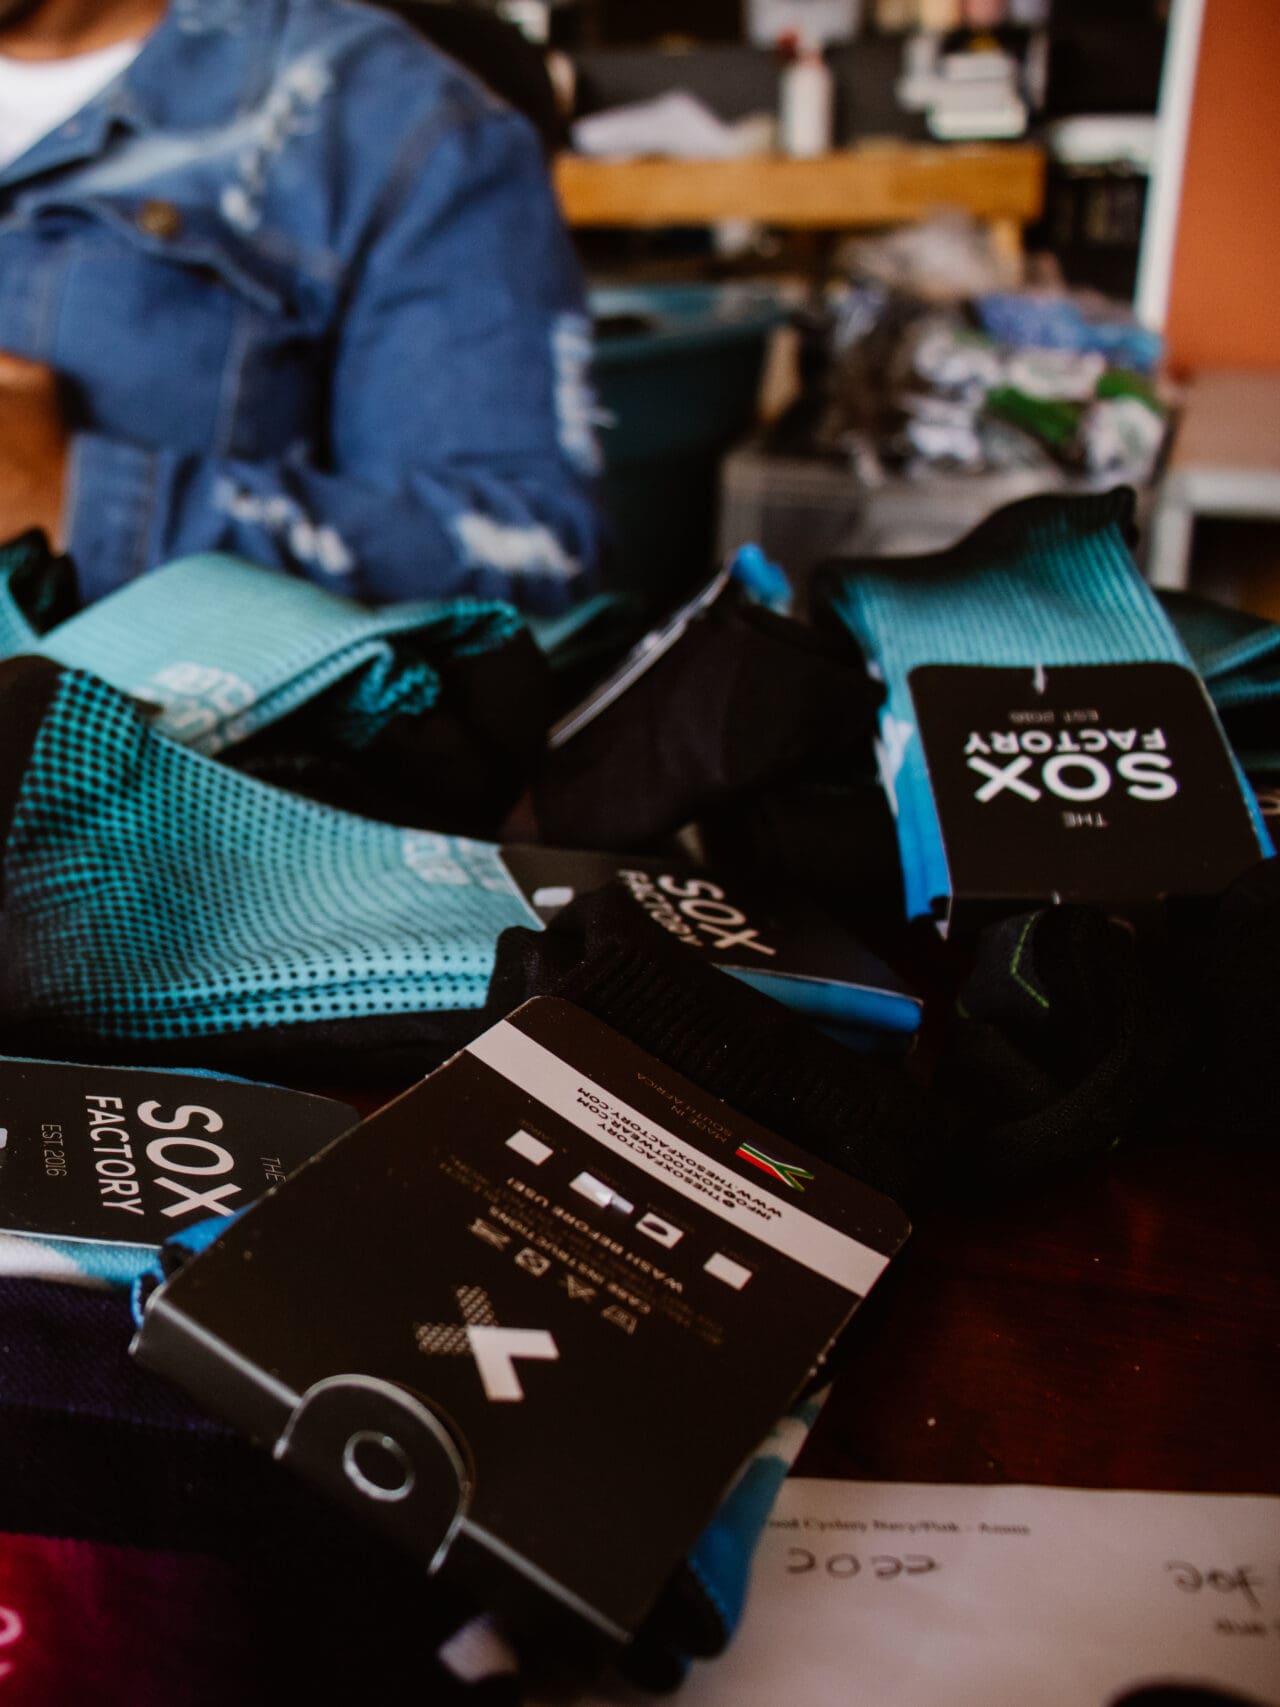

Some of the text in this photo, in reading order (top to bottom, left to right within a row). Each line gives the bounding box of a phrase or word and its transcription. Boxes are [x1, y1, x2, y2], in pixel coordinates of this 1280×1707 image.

[964, 728, 1167, 755] FACTORY
[966, 752, 1178, 803] SOX
[657, 874, 776, 956] SOX
[44, 1149, 67, 1176] 2016
[85, 1095, 145, 1216] FACTORY
[137, 1100, 242, 1218] SOX
[260, 1157, 287, 1182] THE
[577, 1087, 782, 1218] WWW.THESOXFACTORY.COM
